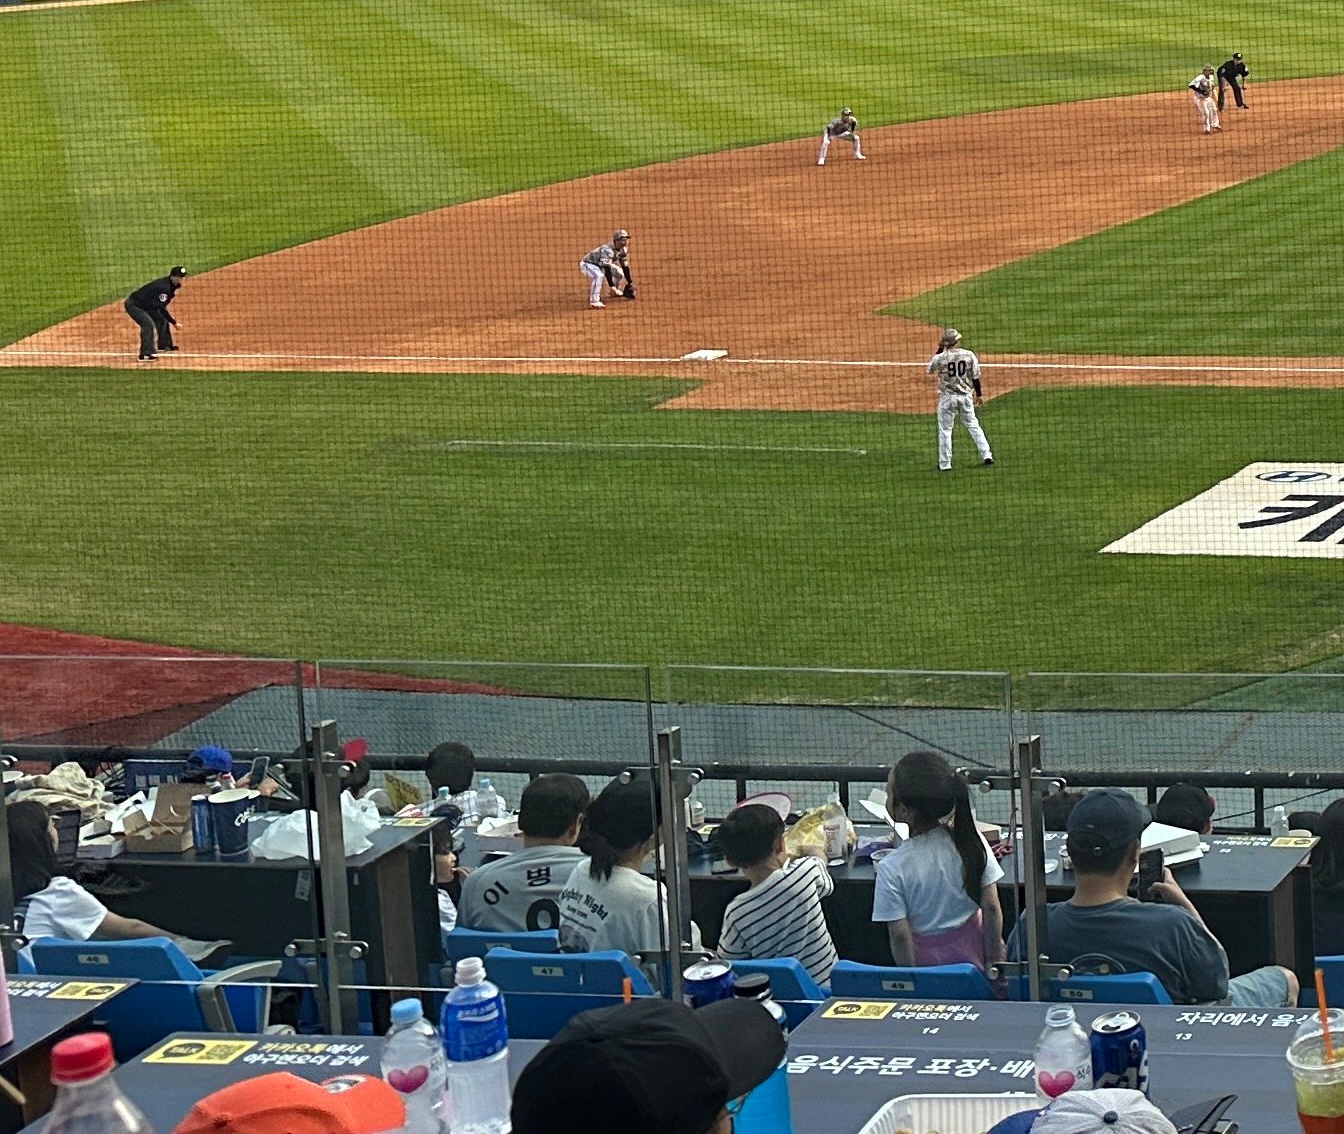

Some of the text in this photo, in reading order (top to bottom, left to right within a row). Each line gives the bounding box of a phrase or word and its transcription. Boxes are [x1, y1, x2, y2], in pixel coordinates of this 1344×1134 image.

[1175, 1012, 1267, 1027] 자리에서
[921, 1027, 939, 1035] 14
[786, 1055, 918, 1075] 음식주문
